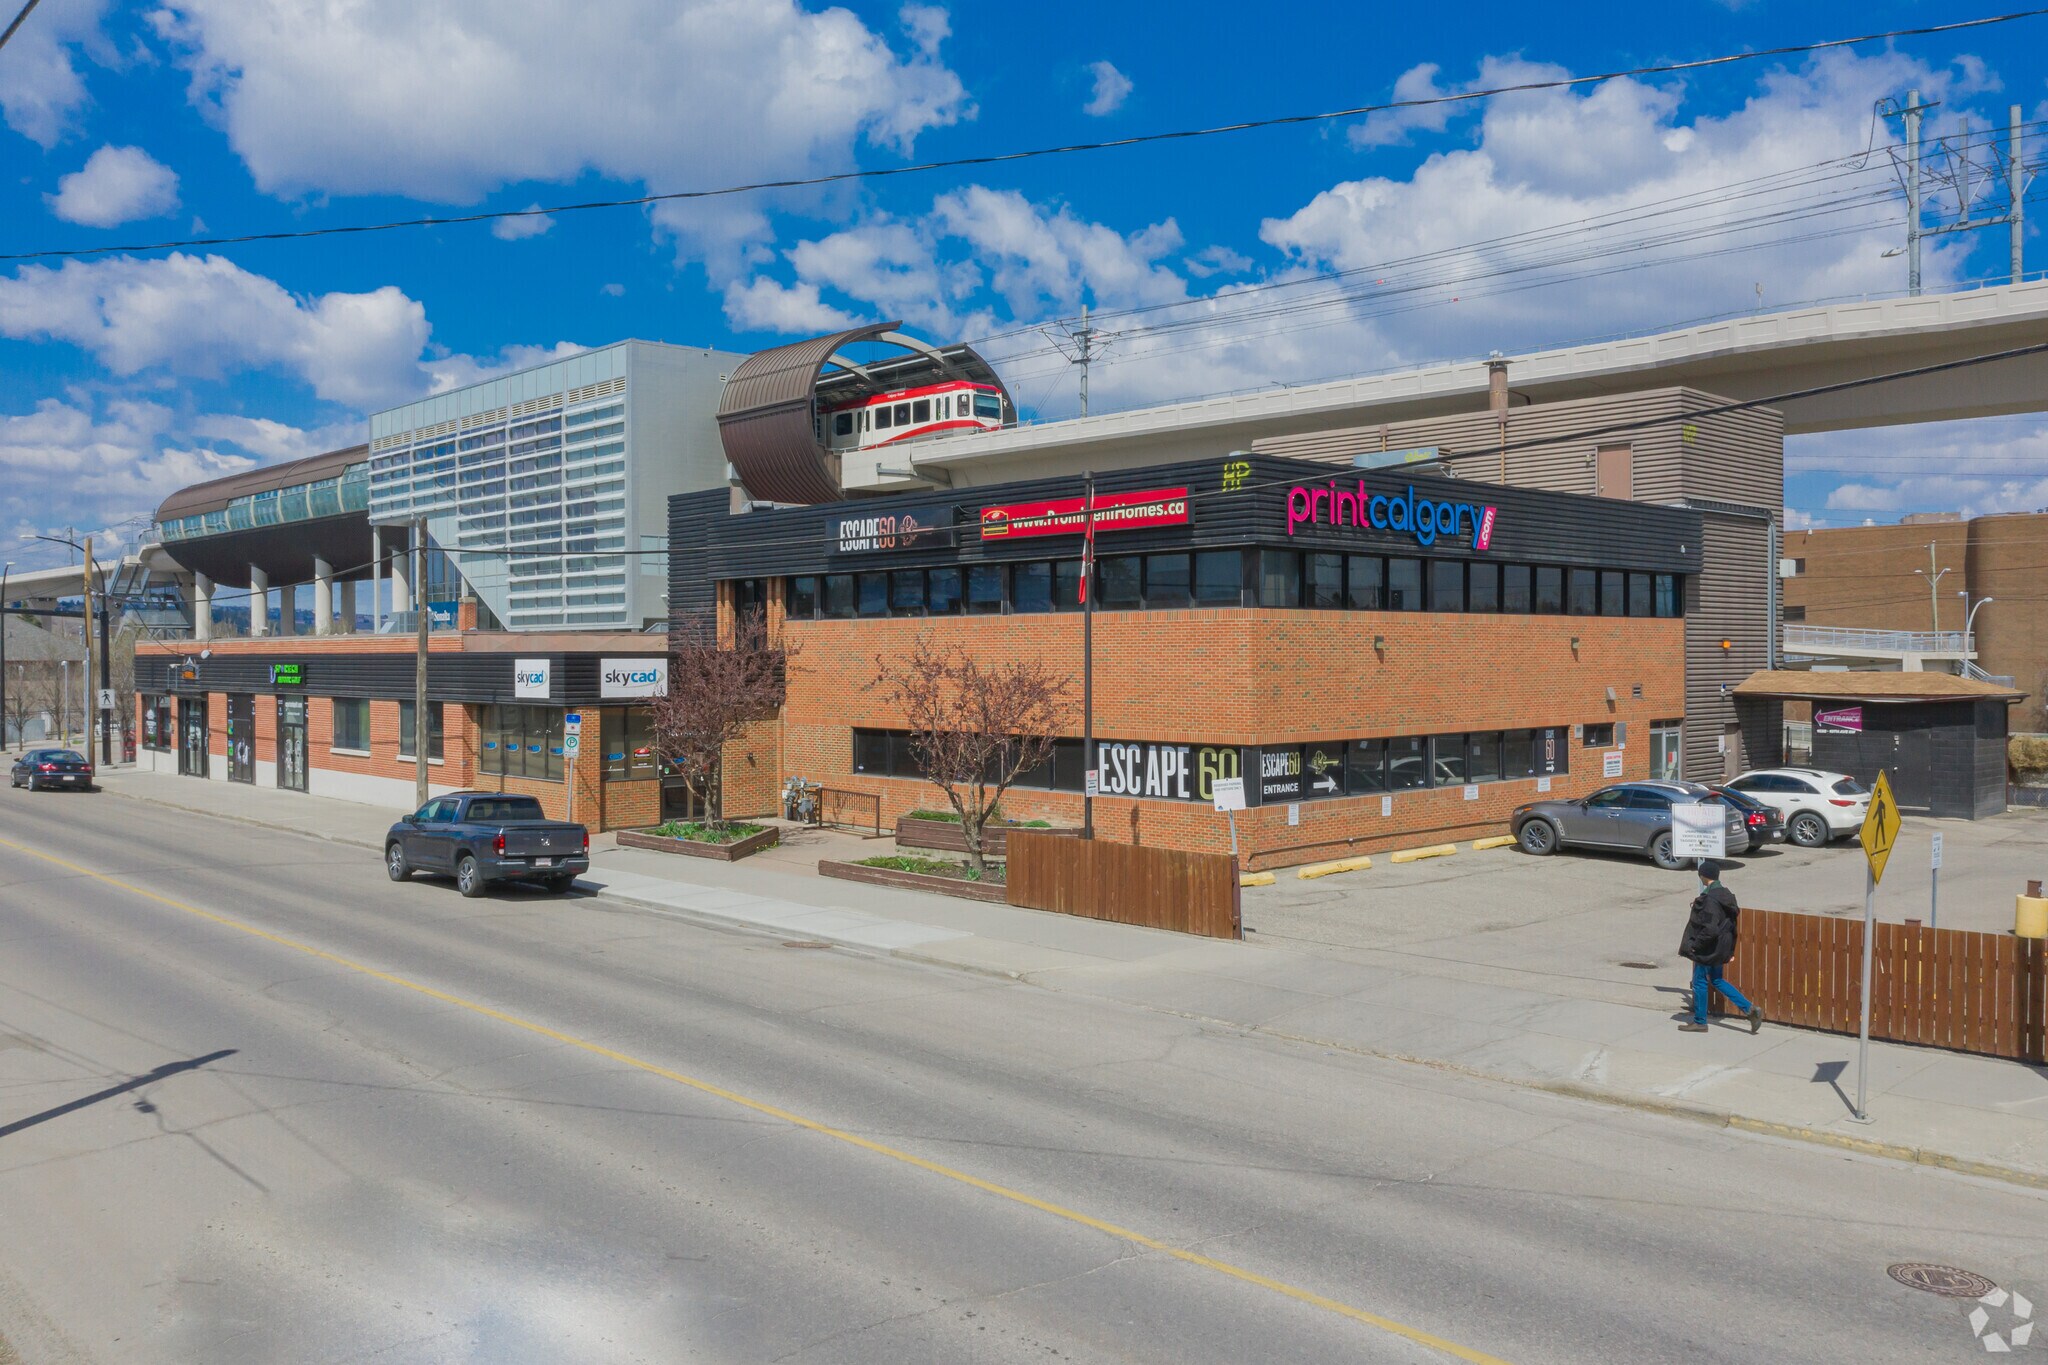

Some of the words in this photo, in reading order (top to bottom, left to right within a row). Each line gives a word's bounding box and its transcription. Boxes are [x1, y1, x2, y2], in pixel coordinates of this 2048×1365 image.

[1287, 480, 1486, 549] printcalgary
[517, 670, 544, 686] skycad
[605, 668, 657, 686] skycad
[1099, 742, 1190, 798] ESCAPE
[1263, 782, 1299, 794] ENTRANCE
